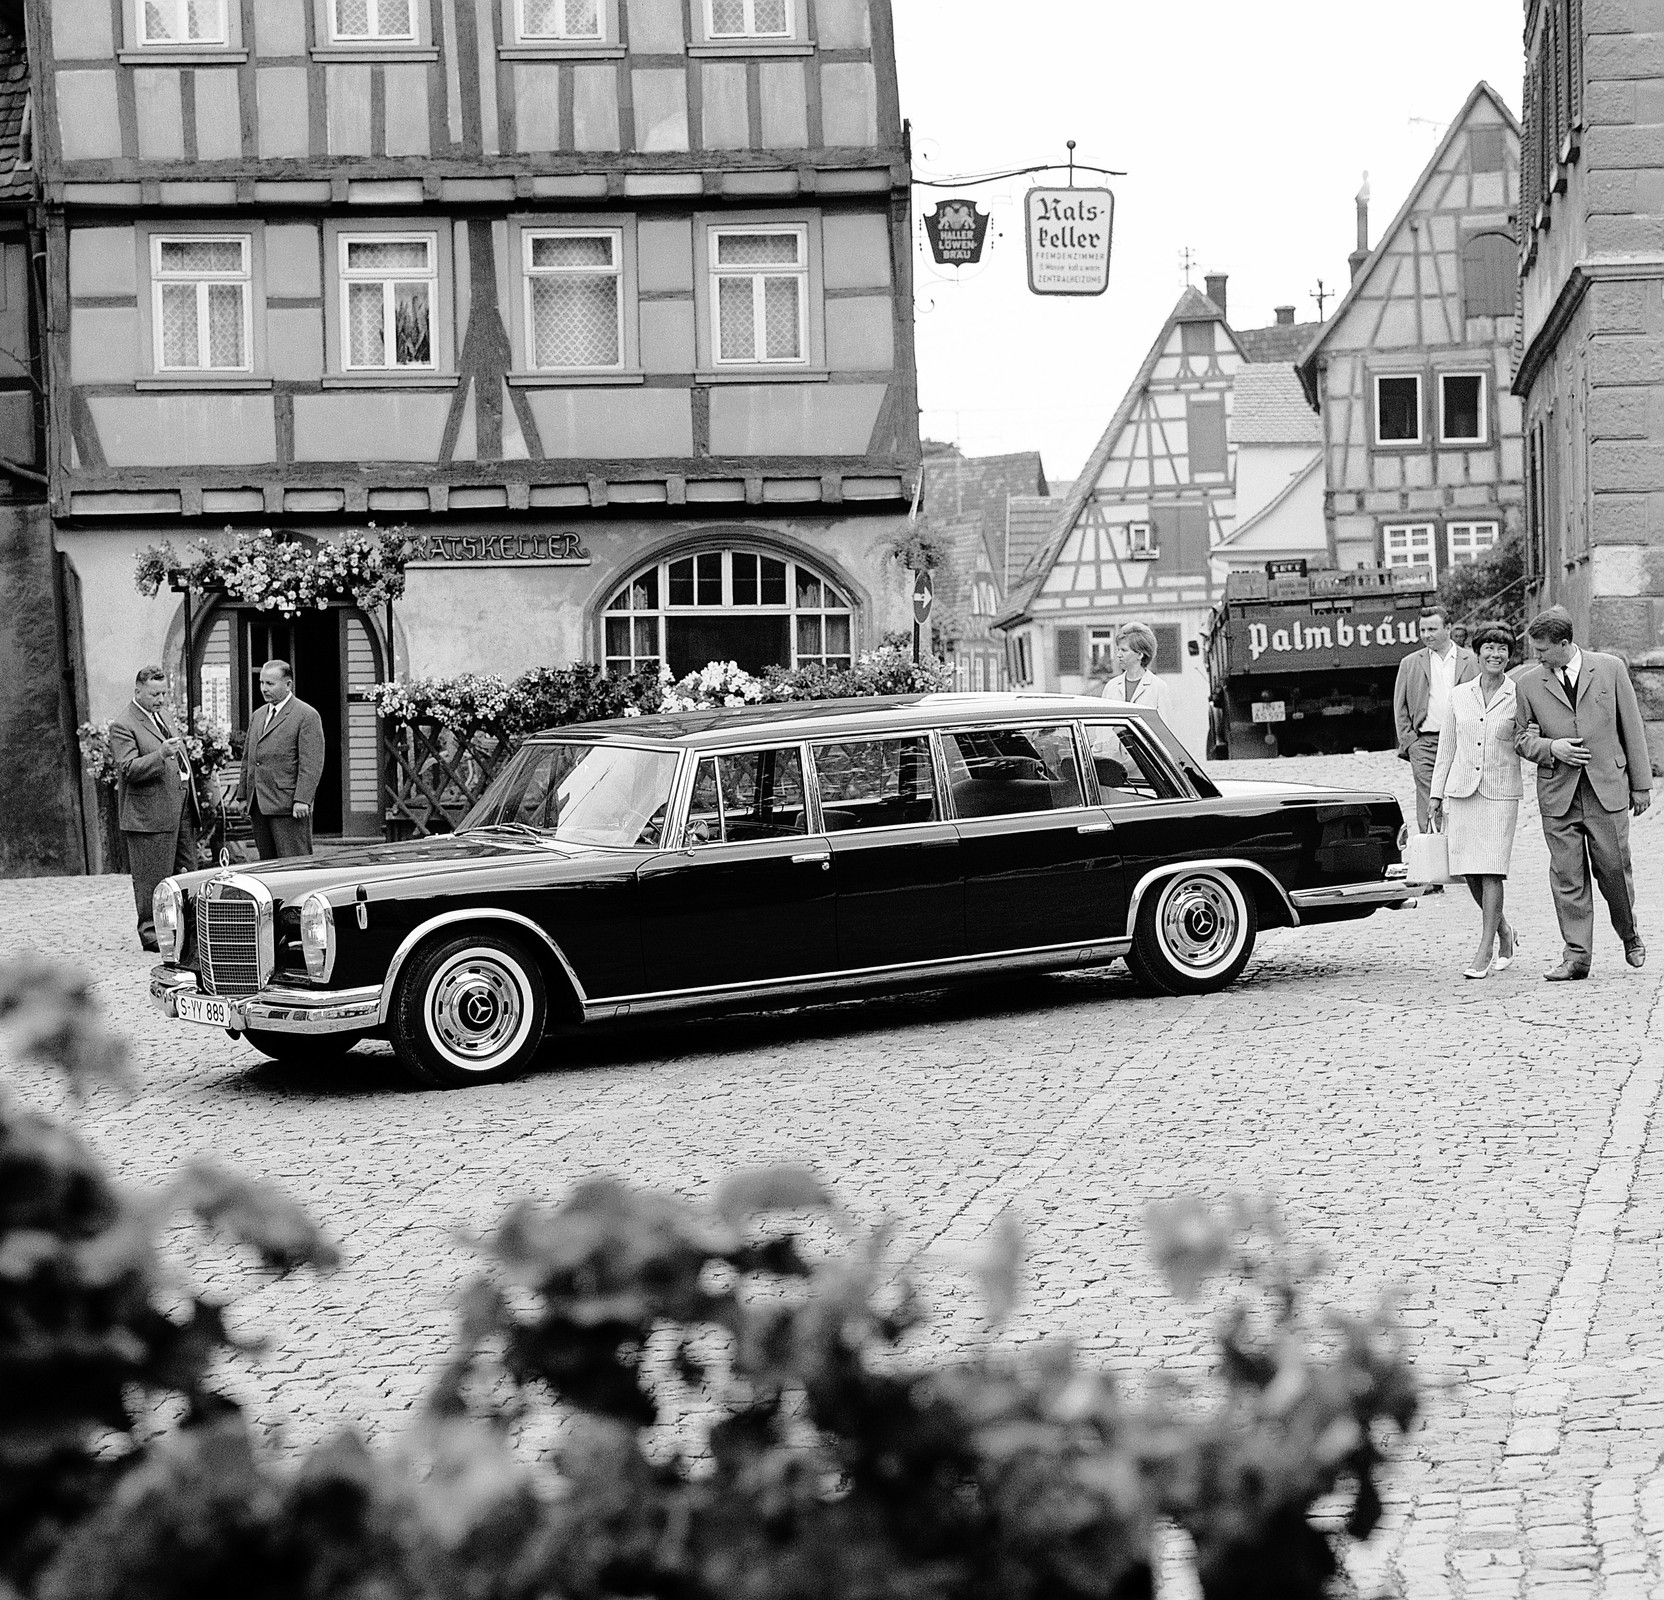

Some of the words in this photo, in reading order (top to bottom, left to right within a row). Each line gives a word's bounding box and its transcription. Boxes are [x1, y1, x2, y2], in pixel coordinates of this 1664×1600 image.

[1037, 197, 1105, 221] Rats-
[940, 230, 974, 240] HALLER
[1038, 226, 1101, 248] keller
[1036, 252, 1105, 260] FREMDENZIMMER
[1038, 275, 1102, 284] ZENTRALHEIZUNG
[1248, 615, 1420, 661] Palmbräu
[206, 1002, 225, 1023] 889
